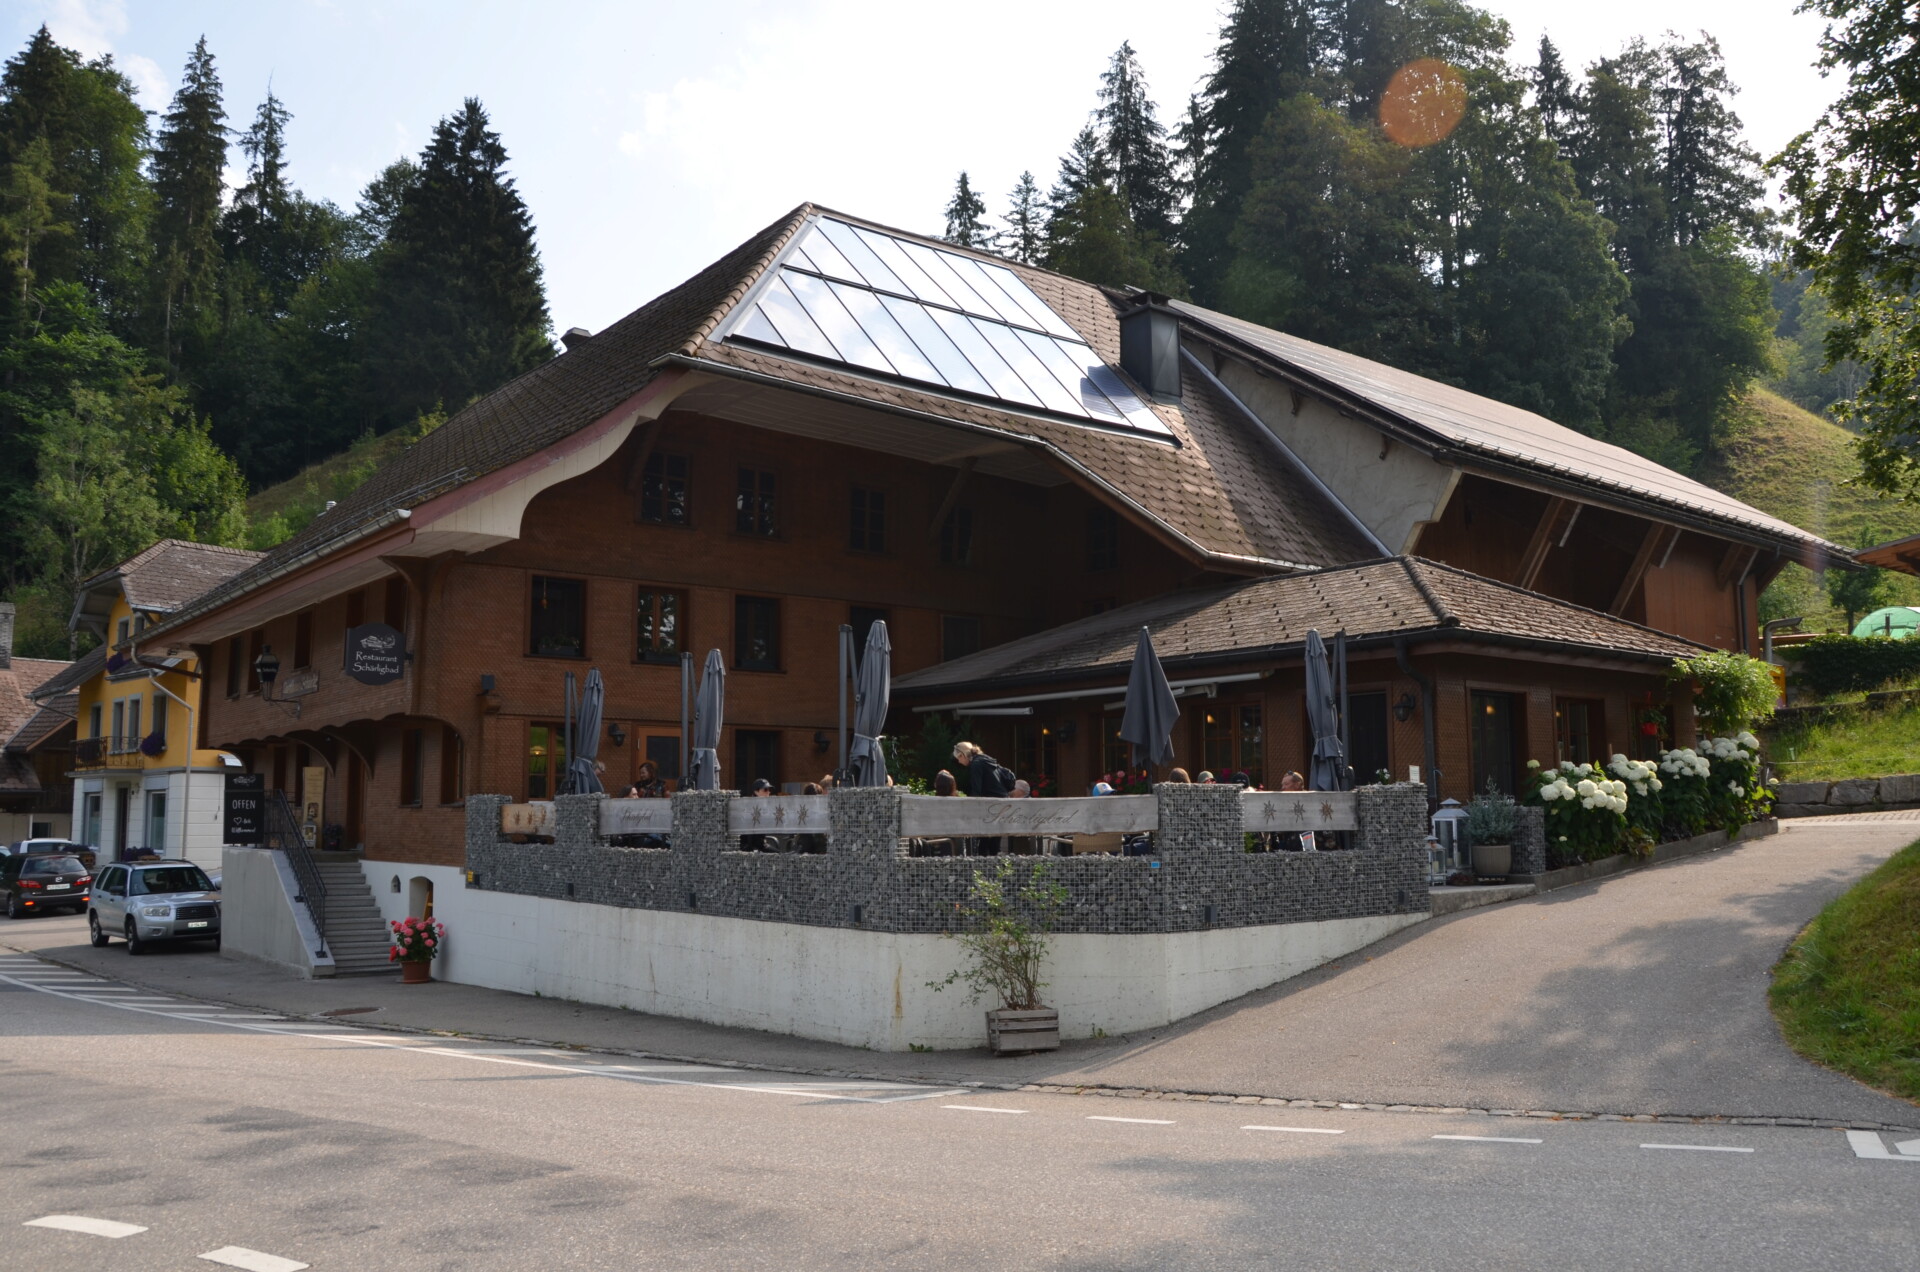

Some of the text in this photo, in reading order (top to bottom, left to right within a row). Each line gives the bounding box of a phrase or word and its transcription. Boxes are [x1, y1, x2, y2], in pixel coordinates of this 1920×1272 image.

[355, 650, 398, 663] Restaurant
[352, 662, 399, 675] Schärligbad
[232, 799, 256, 810] OFFEN
